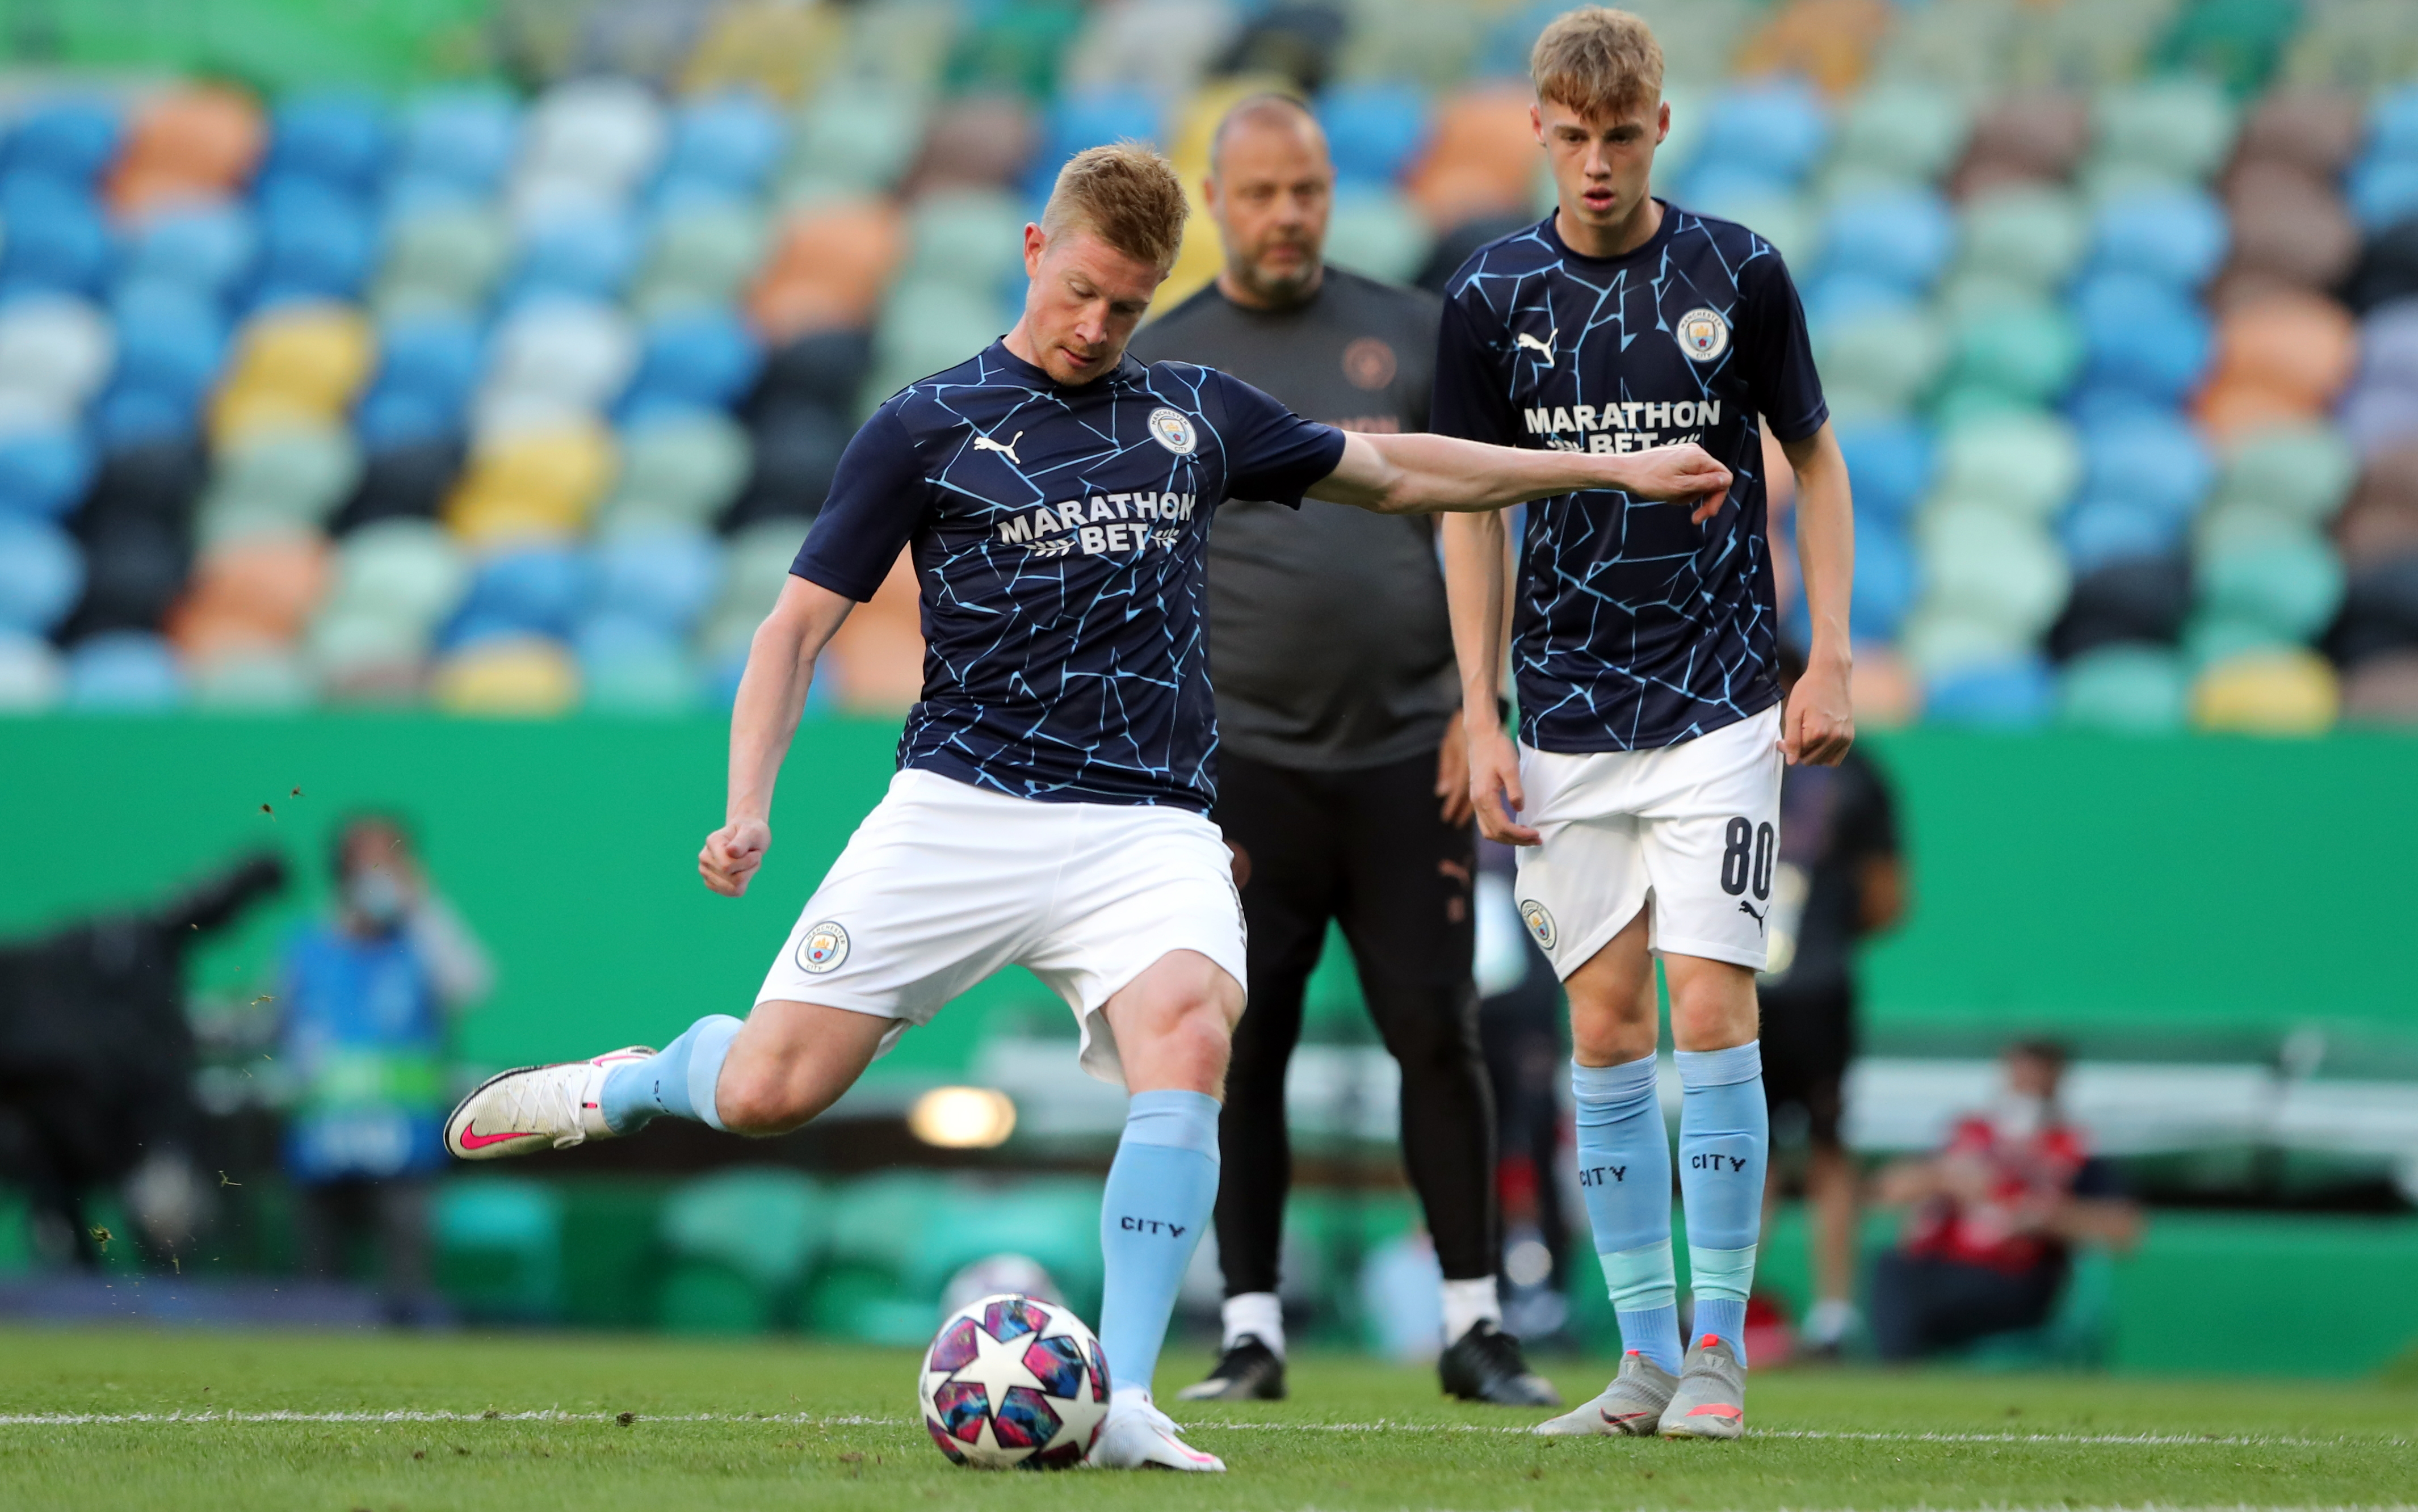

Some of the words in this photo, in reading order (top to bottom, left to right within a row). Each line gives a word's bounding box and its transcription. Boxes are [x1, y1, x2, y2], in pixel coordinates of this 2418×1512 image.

[1681, 312, 1722, 329] MANCHESTER
[1151, 410, 1188, 426] MANCHESTER
[1524, 400, 1721, 434] MARATHON
[997, 492, 1195, 545] MARATHON
[1080, 523, 1150, 555] BET
[1720, 817, 1774, 901] 80
[807, 925, 846, 945] MANCHESTER
[1693, 1153, 1746, 1172] CITY
[1579, 1165, 1627, 1187] CITY
[1121, 1216, 1186, 1238] CITY
